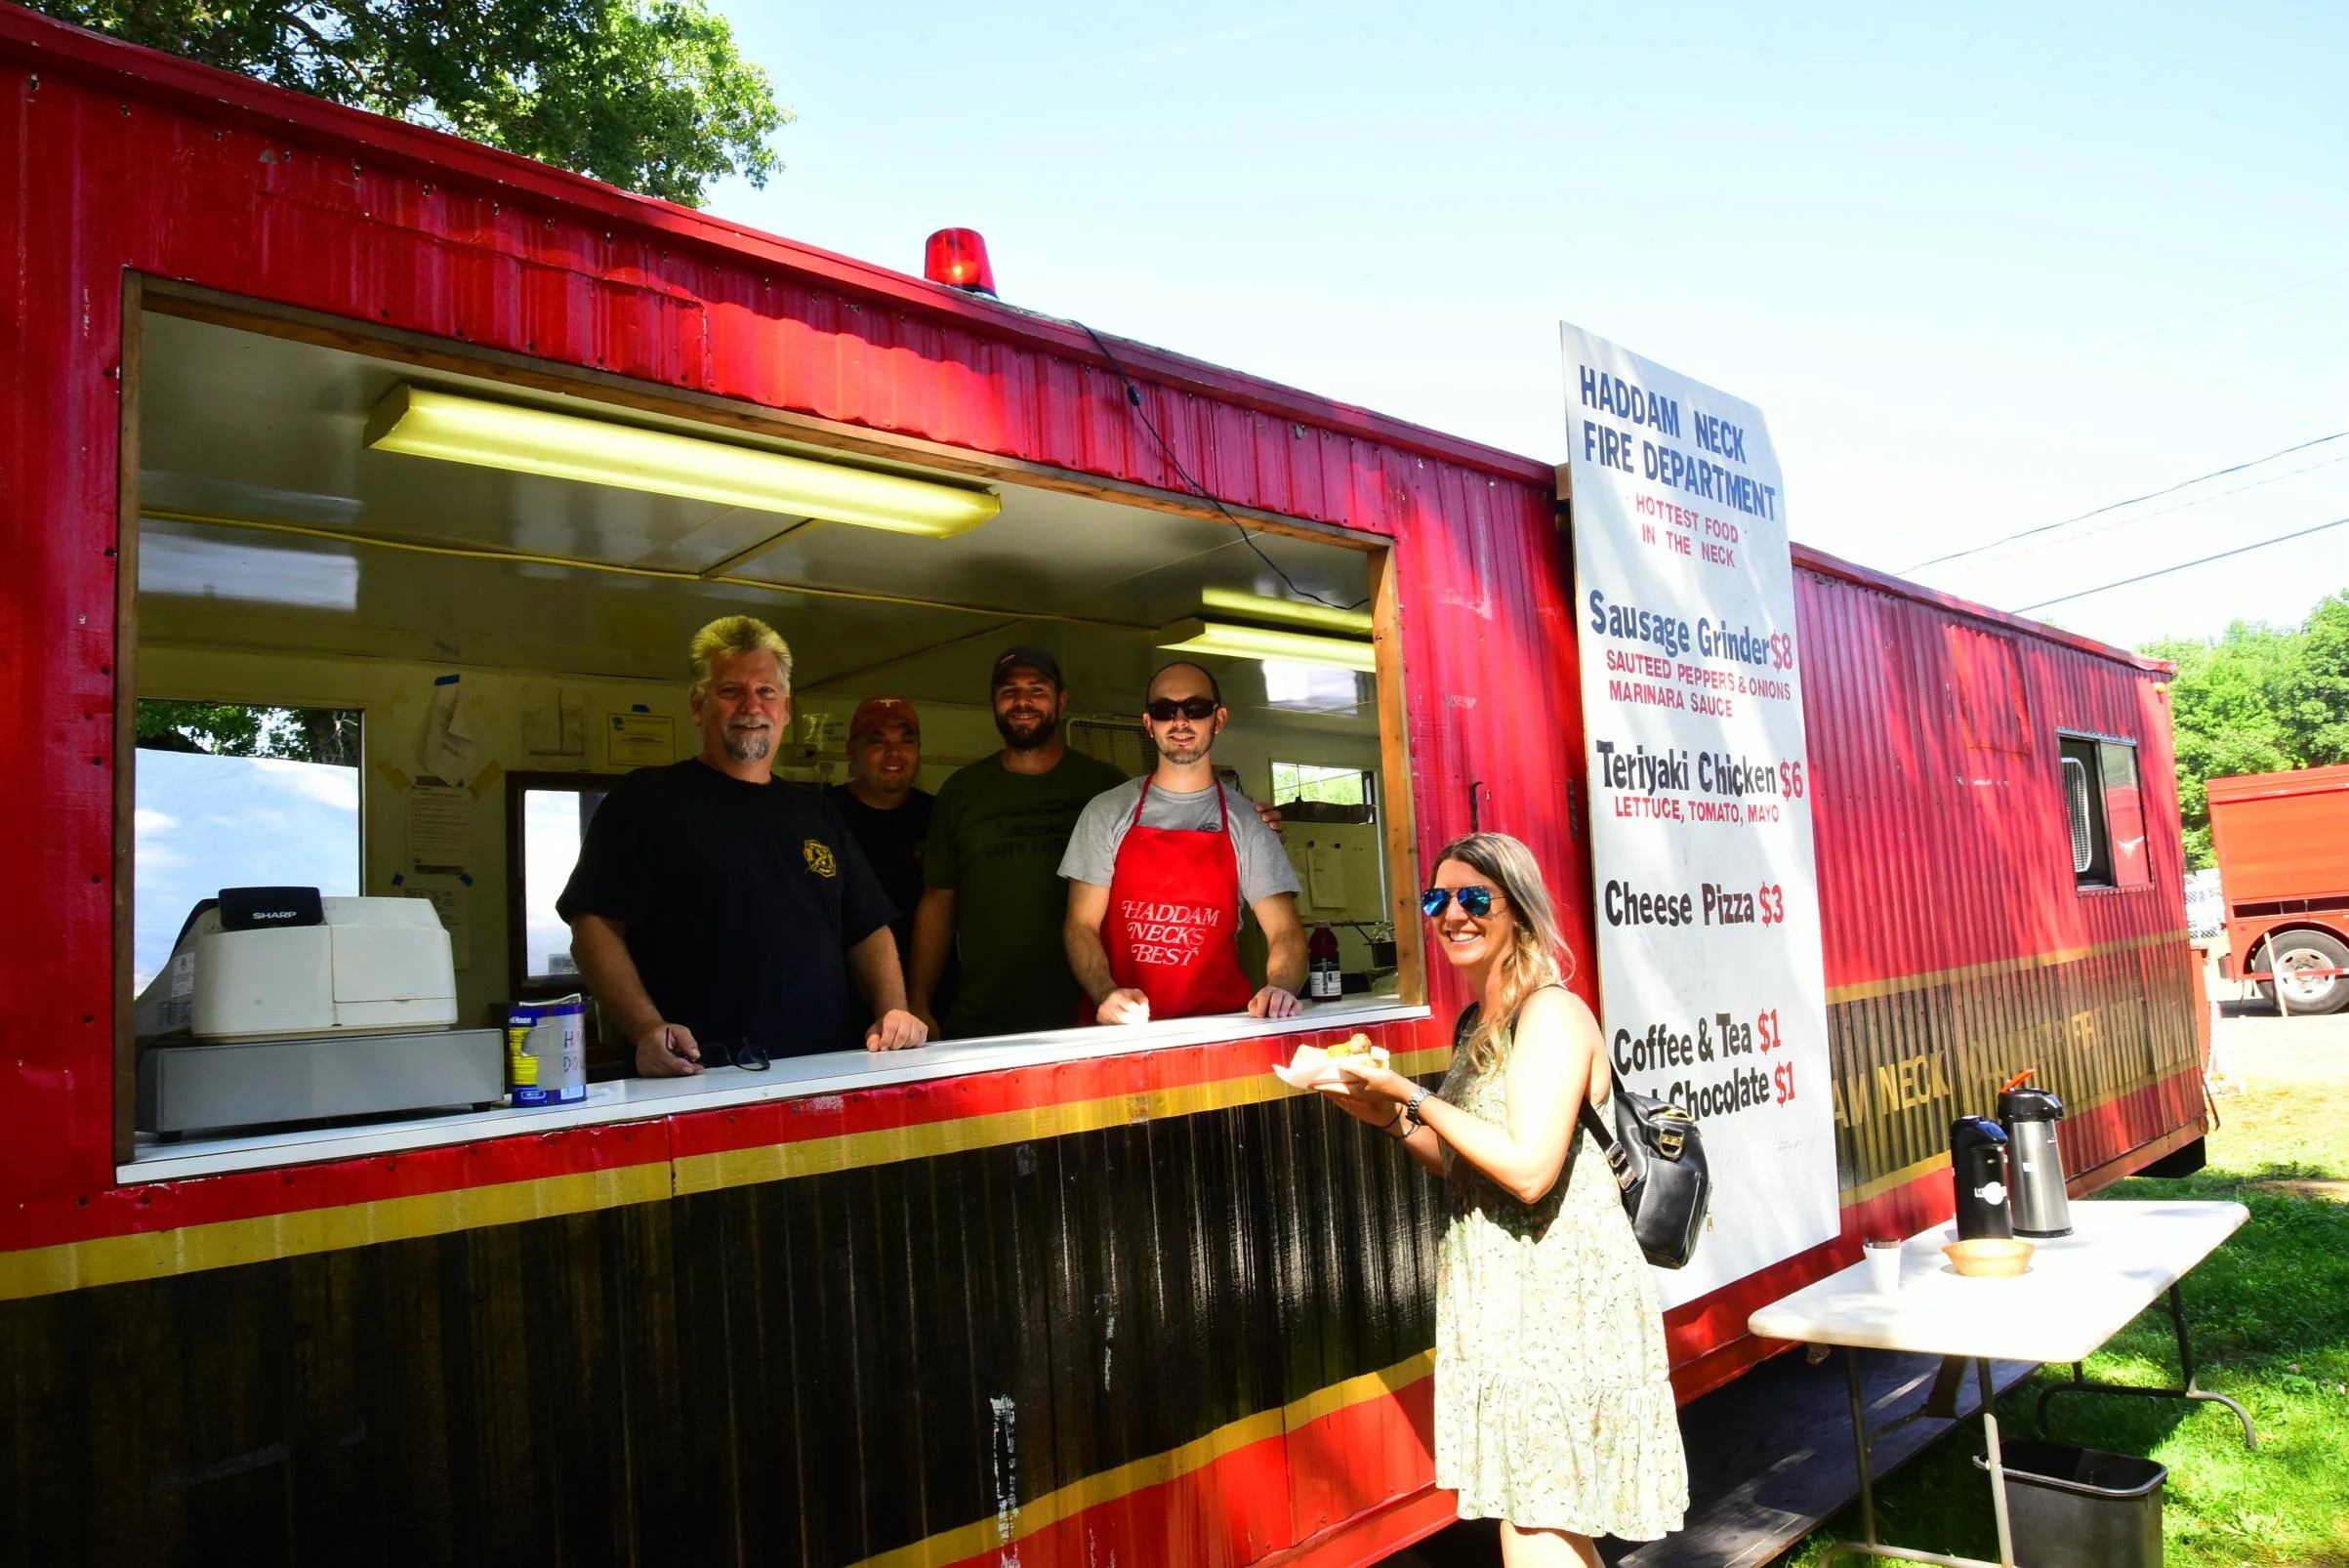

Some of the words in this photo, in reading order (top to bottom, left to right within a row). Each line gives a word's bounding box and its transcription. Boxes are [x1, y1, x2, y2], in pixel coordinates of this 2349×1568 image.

[1579, 364, 1681, 438] HADDAM
[1694, 410, 1747, 464] NECK
[1584, 420, 1634, 474] FIRE
[1643, 440, 1776, 521] DEPARTMENT
[1636, 492, 1699, 531] HOTTEST
[1705, 516, 1739, 544] FOOD
[1642, 523, 1656, 545] IN
[1666, 531, 1691, 556] THE
[1702, 541, 1736, 568] NECK
[1589, 589, 1690, 658] Sausage
[1697, 617, 1770, 666] Grinder
[1770, 630, 1793, 674] $8
[1606, 649, 1672, 679] SAUTEED
[1677, 663, 1736, 691] PEPPERS
[1739, 676, 1747, 694] &
[1749, 678, 1792, 701] ONIONS
[1609, 680, 1685, 710] MARINARA
[1690, 692, 1733, 718] SAUCE
[1595, 739, 1690, 796] Teriyaki
[1698, 751, 1777, 798] Chicken
[1779, 758, 1803, 802] $6
[1615, 796, 1685, 823] LETTUCE,
[1688, 800, 1744, 827] TOMATO,
[1748, 804, 1779, 823] MAYO
[252, 911, 298, 920] SHARP
[1121, 900, 1220, 928] HADDAM
[1605, 880, 1693, 927] Cheese
[1701, 883, 1754, 927] Pizza
[1758, 882, 1784, 928] $3
[1131, 943, 1200, 967] BEST
[1613, 1023, 1694, 1076] Coffee
[1698, 1017, 1714, 1062] &
[1715, 1012, 1753, 1058] Tea
[1757, 1008, 1782, 1055] $1
[1669, 1066, 1770, 1123] Chocolate
[1774, 1060, 1796, 1108] $1
[1877, 1052, 1951, 1115] NECK
